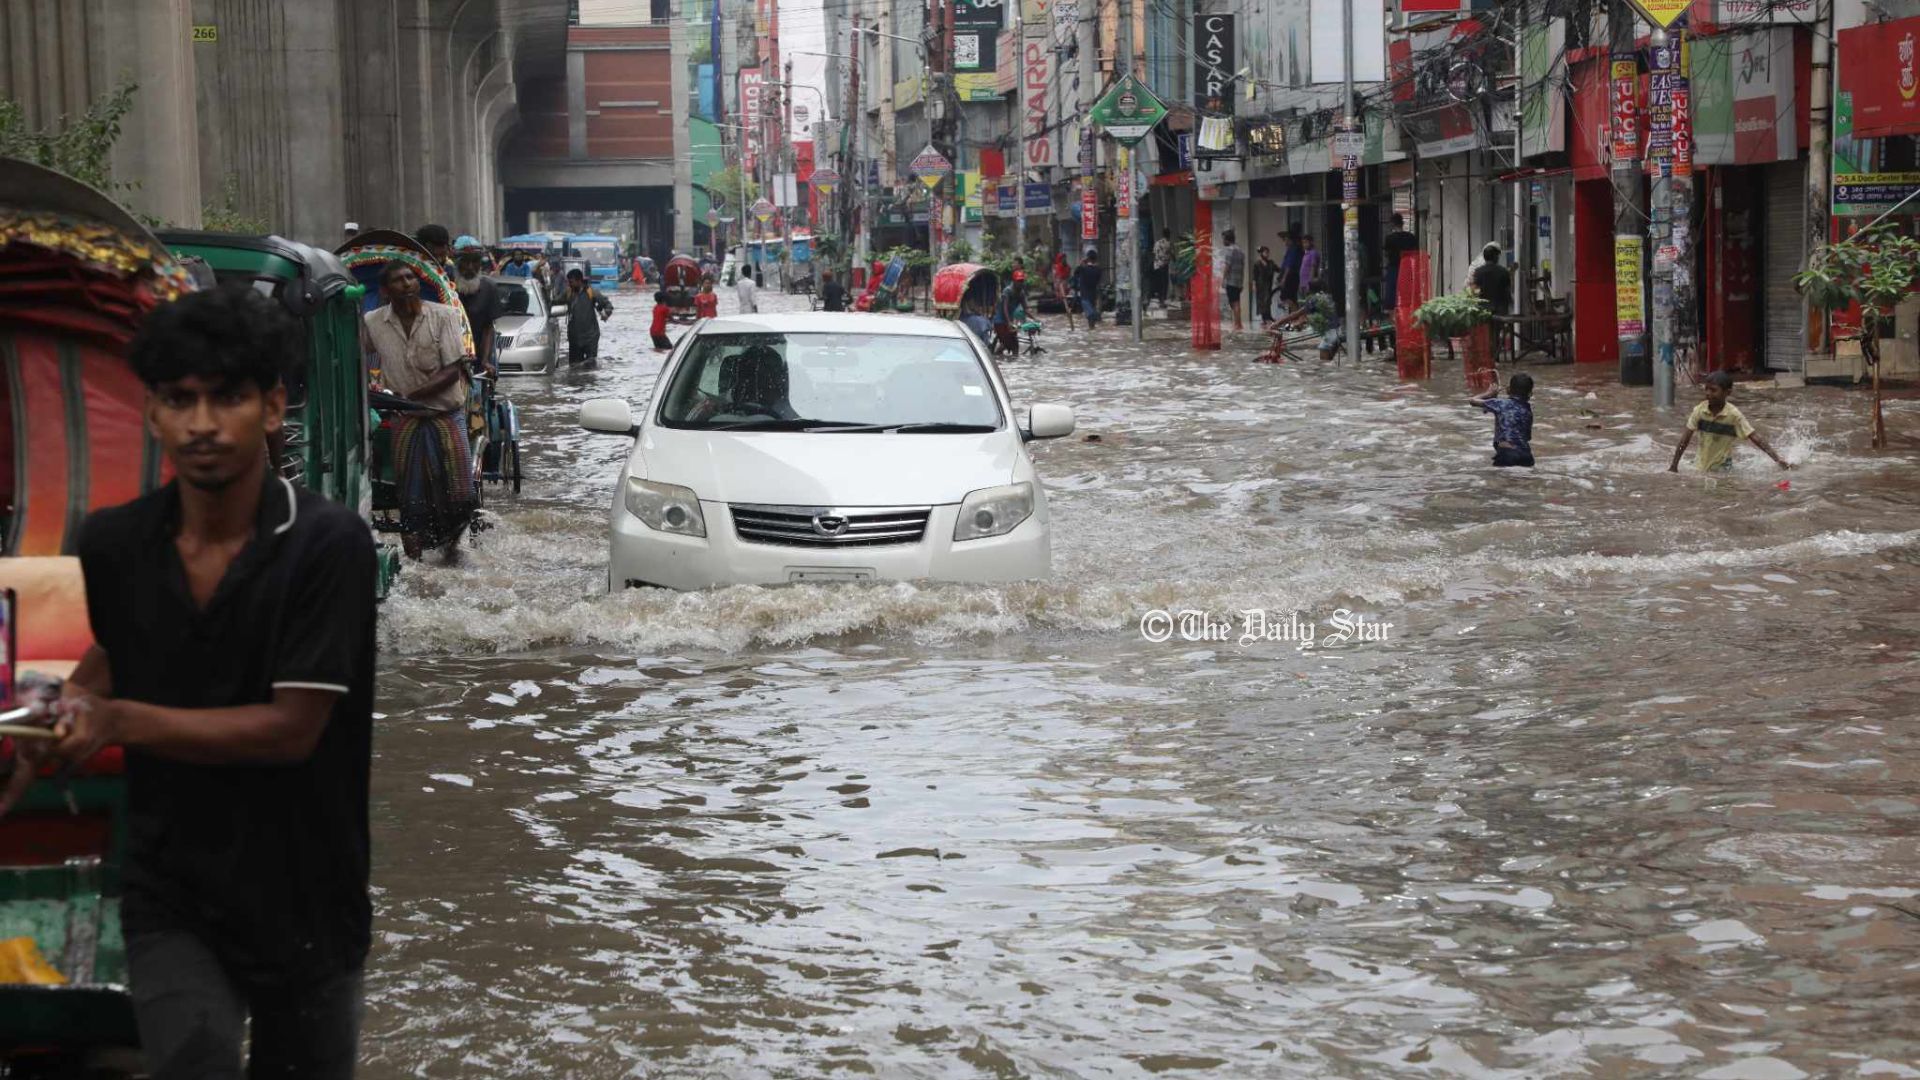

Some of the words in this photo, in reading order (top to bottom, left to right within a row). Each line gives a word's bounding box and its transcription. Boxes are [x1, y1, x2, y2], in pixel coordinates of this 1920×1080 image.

[194, 28, 215, 39] 266
[1205, 17, 1224, 96] CASAR
[1025, 43, 1050, 164] SHARP
